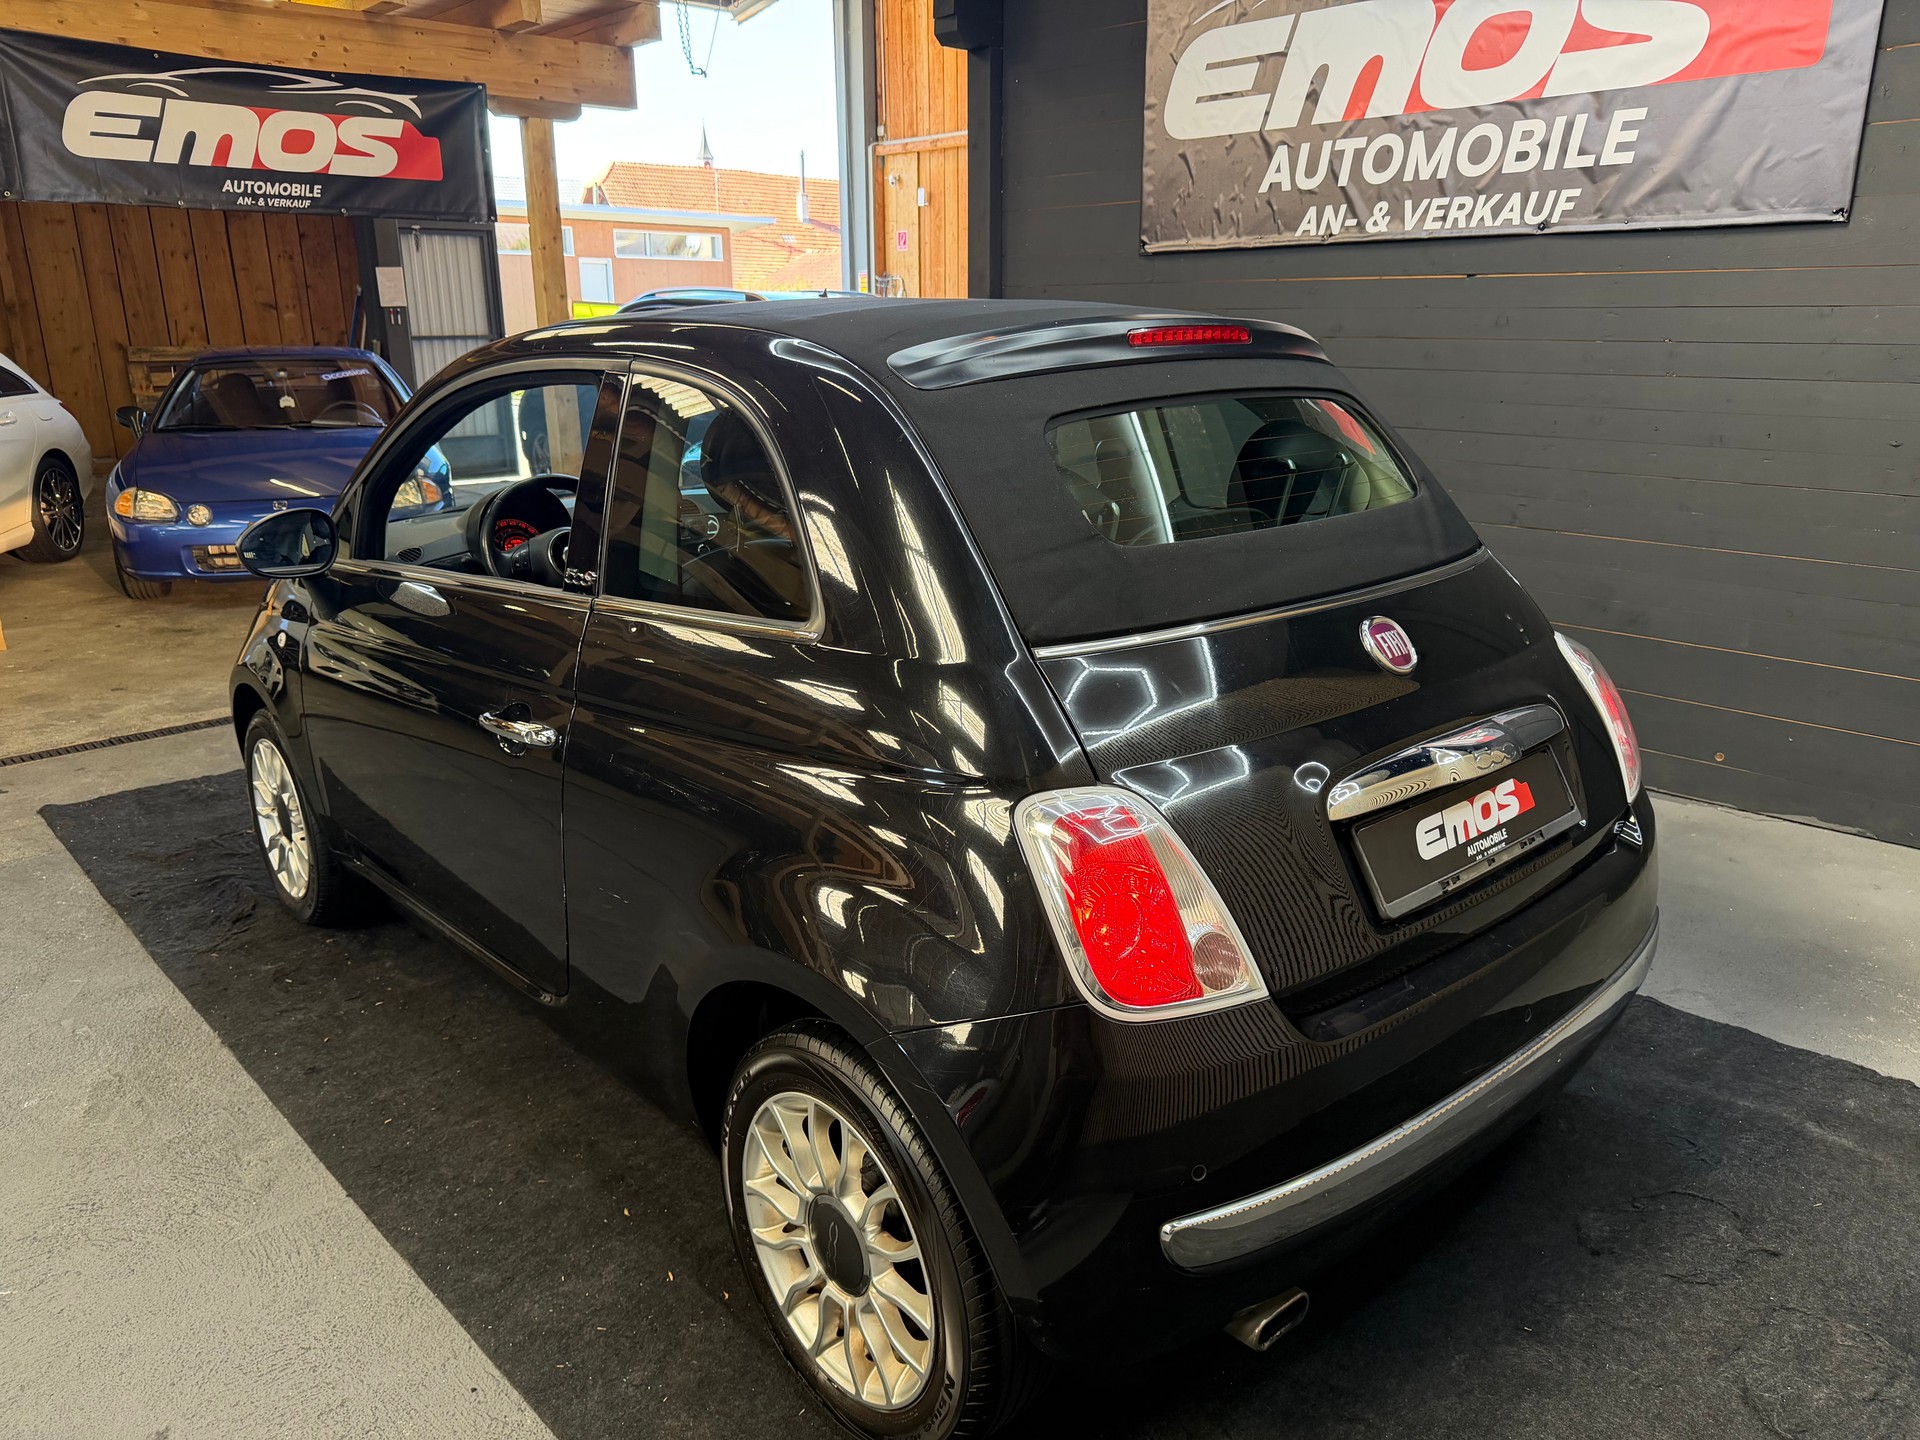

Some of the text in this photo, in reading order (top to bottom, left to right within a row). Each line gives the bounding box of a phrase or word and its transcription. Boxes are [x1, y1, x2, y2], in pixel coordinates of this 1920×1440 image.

[1258, 107, 1648, 194] AUTOMOBILE
[222, 179, 322, 198] AUTOMOBILE
[236, 196, 311, 209] AN- & VERKAUF
[1295, 188, 1582, 237] AN- & VERKAUF
[1374, 629, 1409, 660] FIAT
[1467, 828, 1508, 857] AUTOMOBILE
